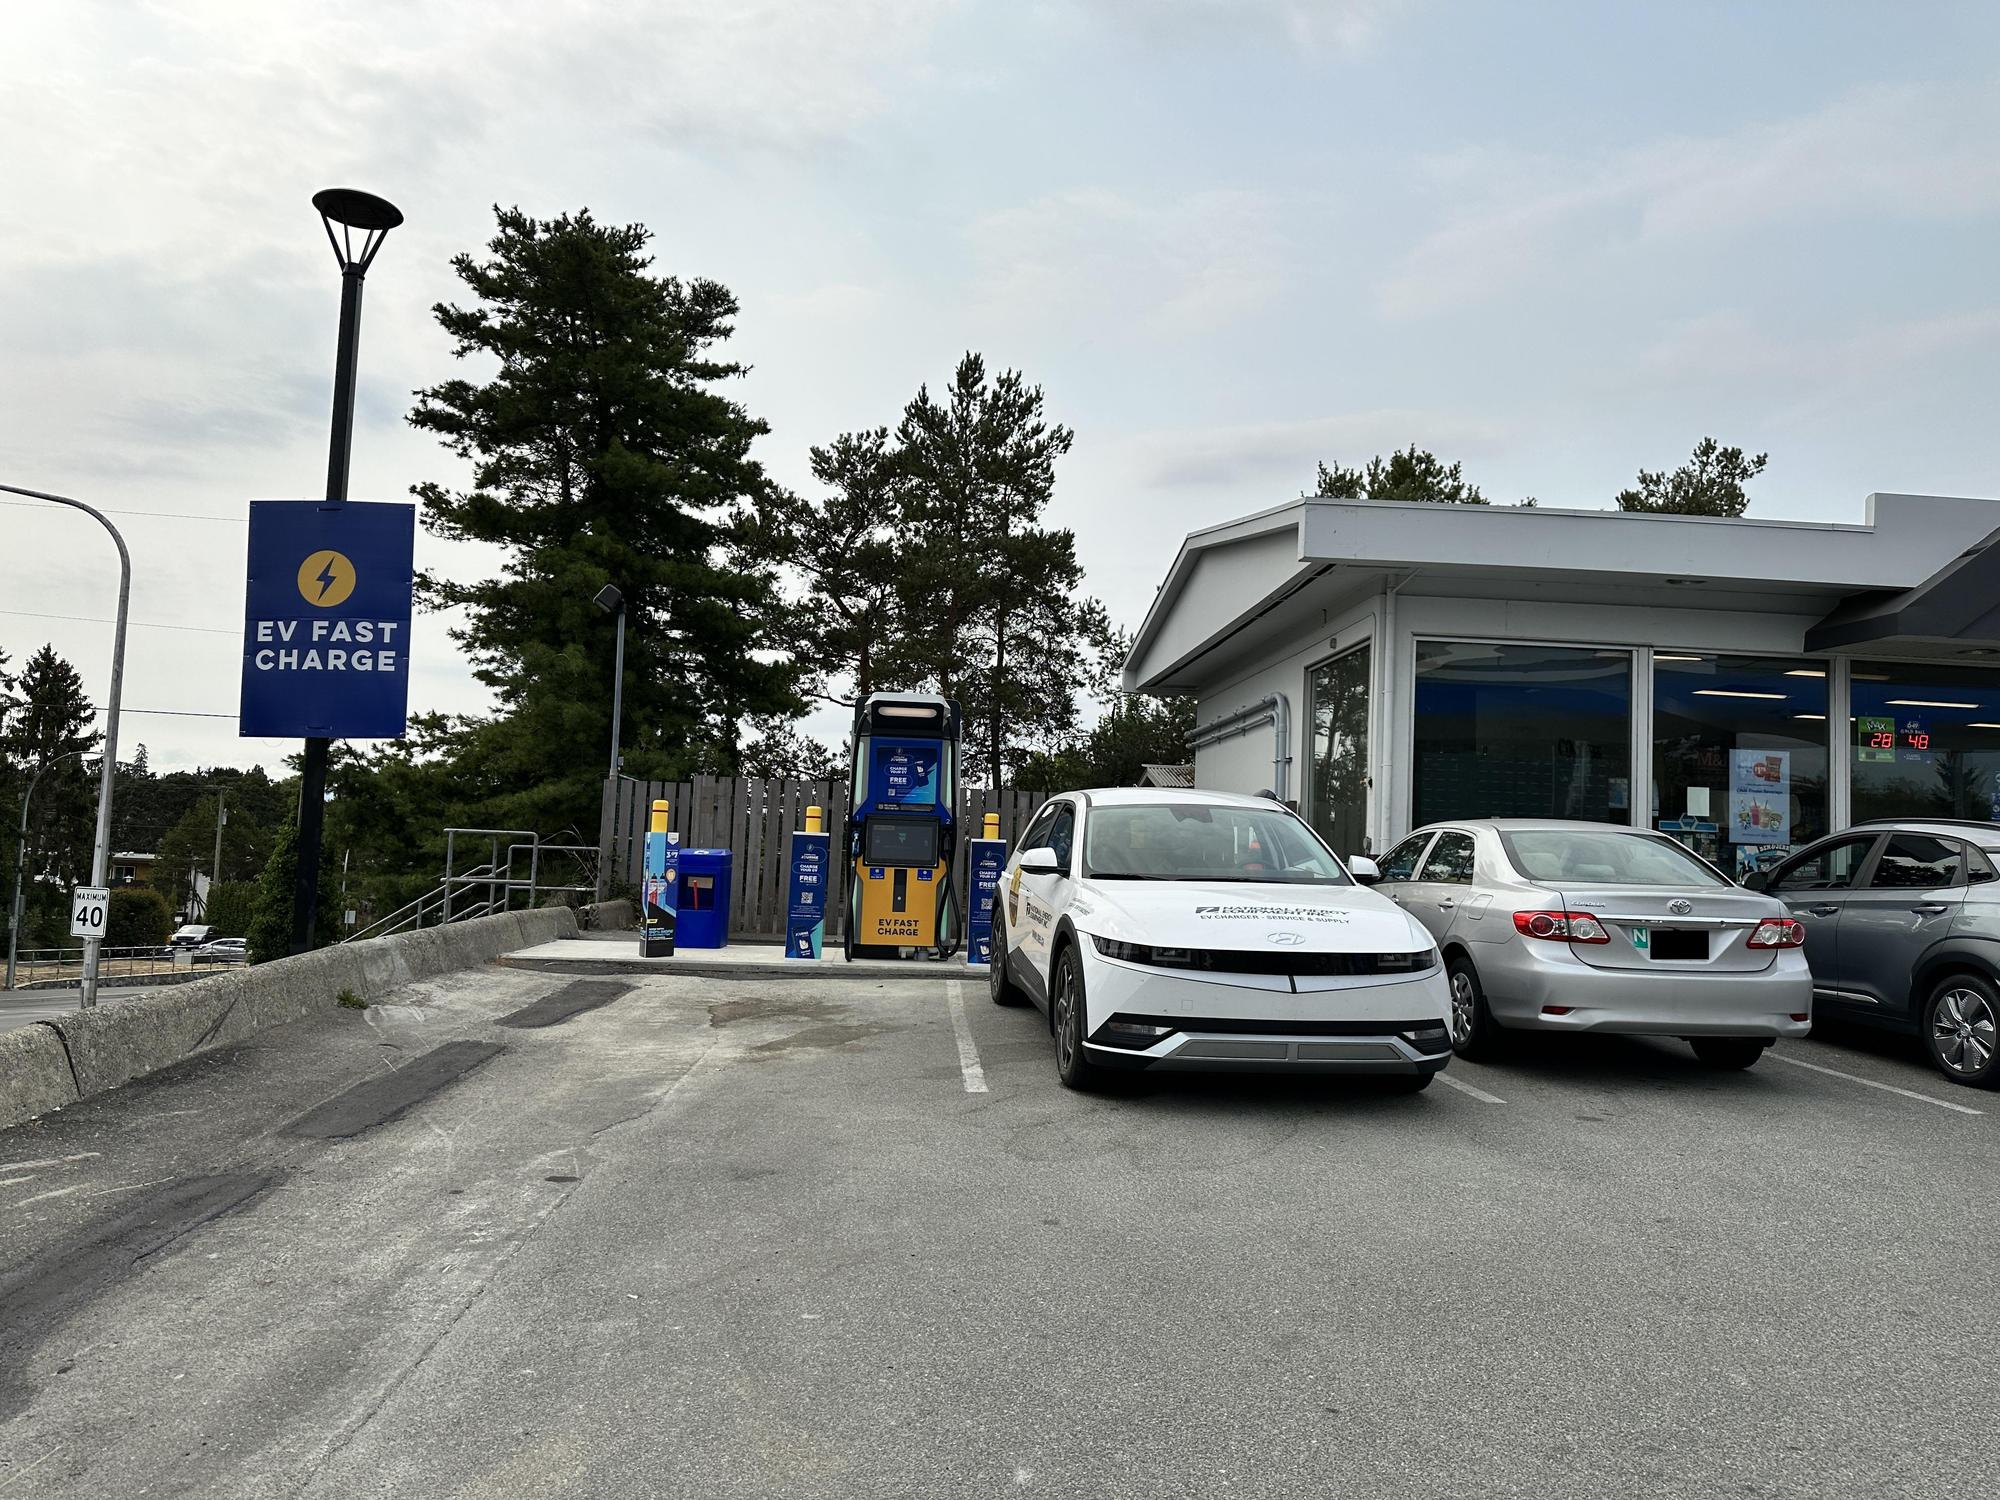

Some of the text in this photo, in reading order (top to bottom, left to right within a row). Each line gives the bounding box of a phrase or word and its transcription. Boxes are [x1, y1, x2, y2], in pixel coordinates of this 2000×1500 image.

[257, 620, 398, 643] EV FAST
[255, 649, 396, 672] CHARGE
[1866, 721, 1887, 731] MAX
[1871, 732, 1893, 749] 28
[1908, 734, 1929, 750] 48
[76, 892, 107, 901] MAXIMUM
[76, 905, 103, 927] 40
[878, 918, 919, 927] EV FAST
[877, 927, 919, 936] CHARGE
[1633, 928, 1648, 943] N
